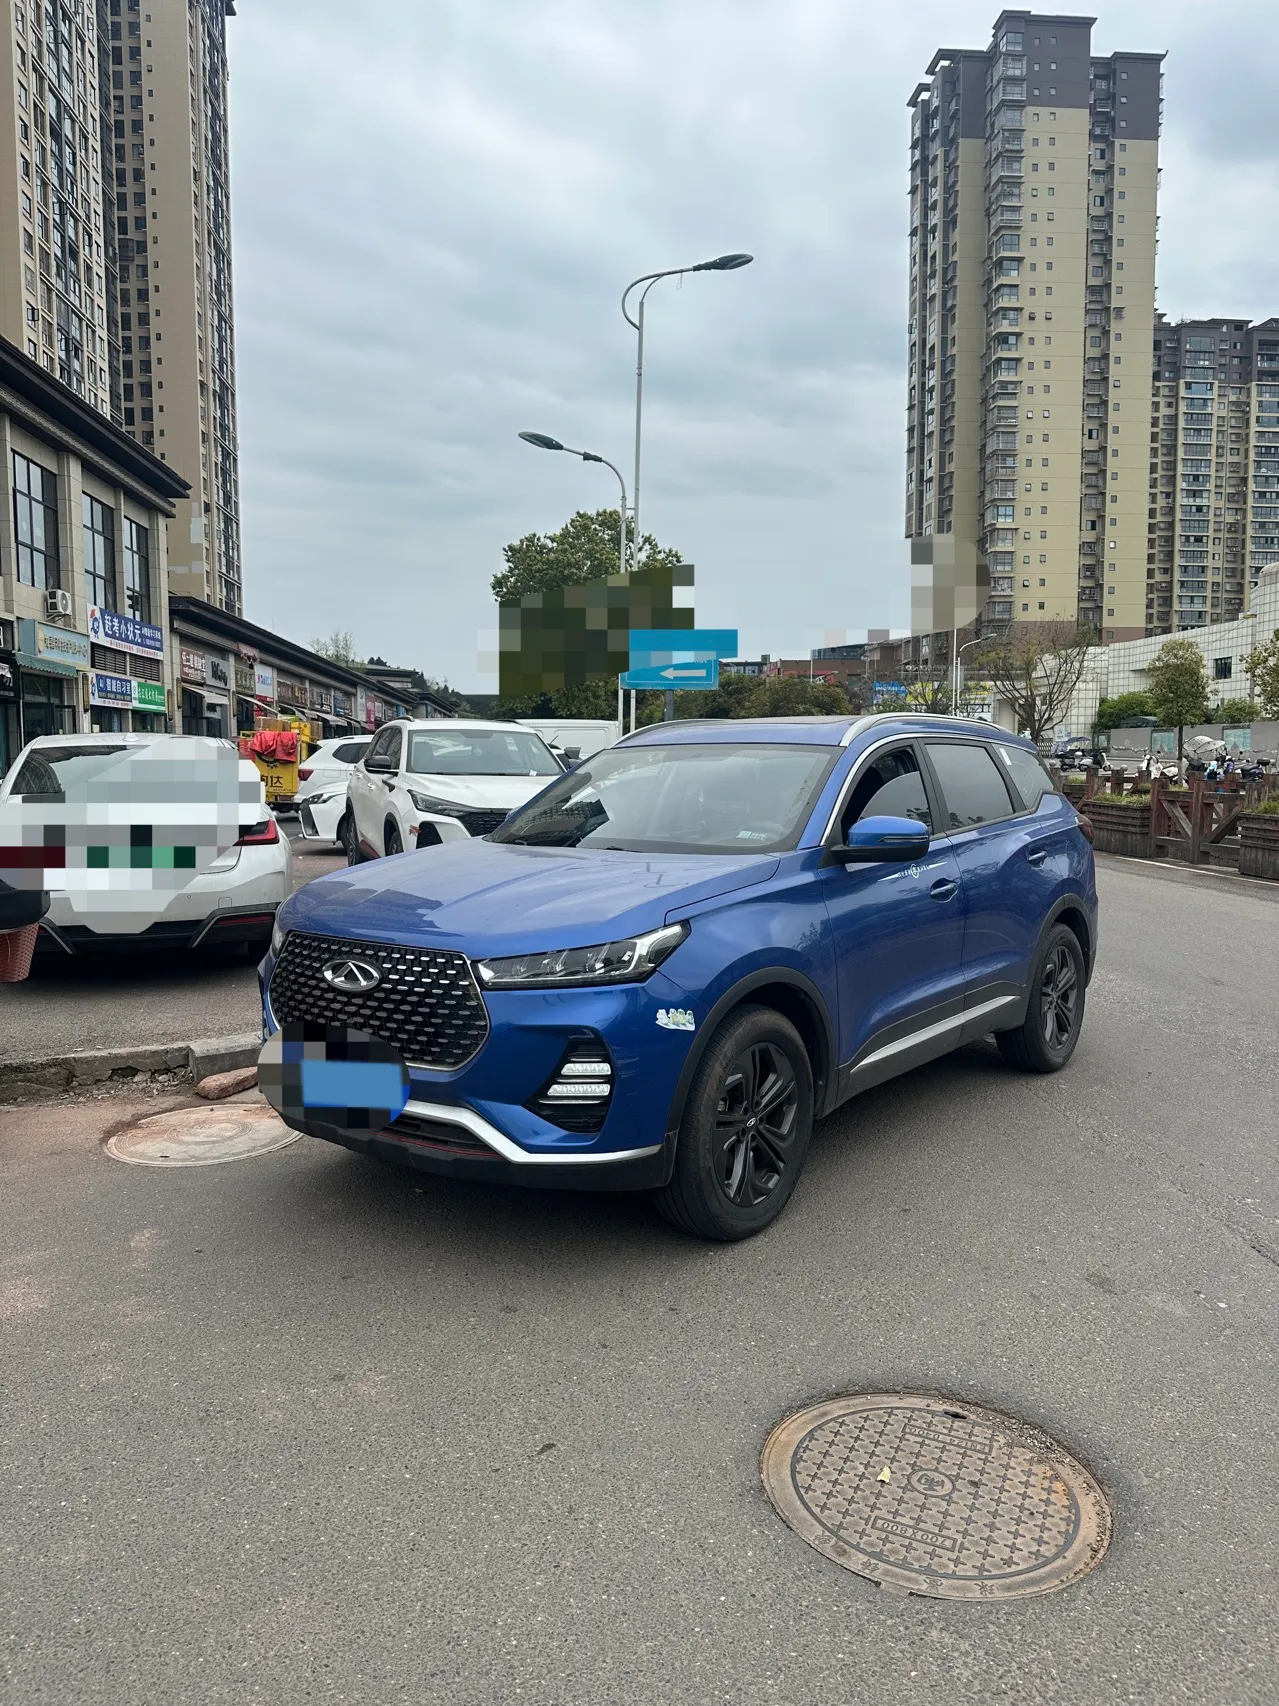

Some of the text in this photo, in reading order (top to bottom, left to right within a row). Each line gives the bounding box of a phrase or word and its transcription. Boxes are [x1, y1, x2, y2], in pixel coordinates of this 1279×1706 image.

[104, 614, 142, 643] 赶考小状元
[106, 678, 132, 695] 智能自习室
[880, 1520, 949, 1548] 700X800
